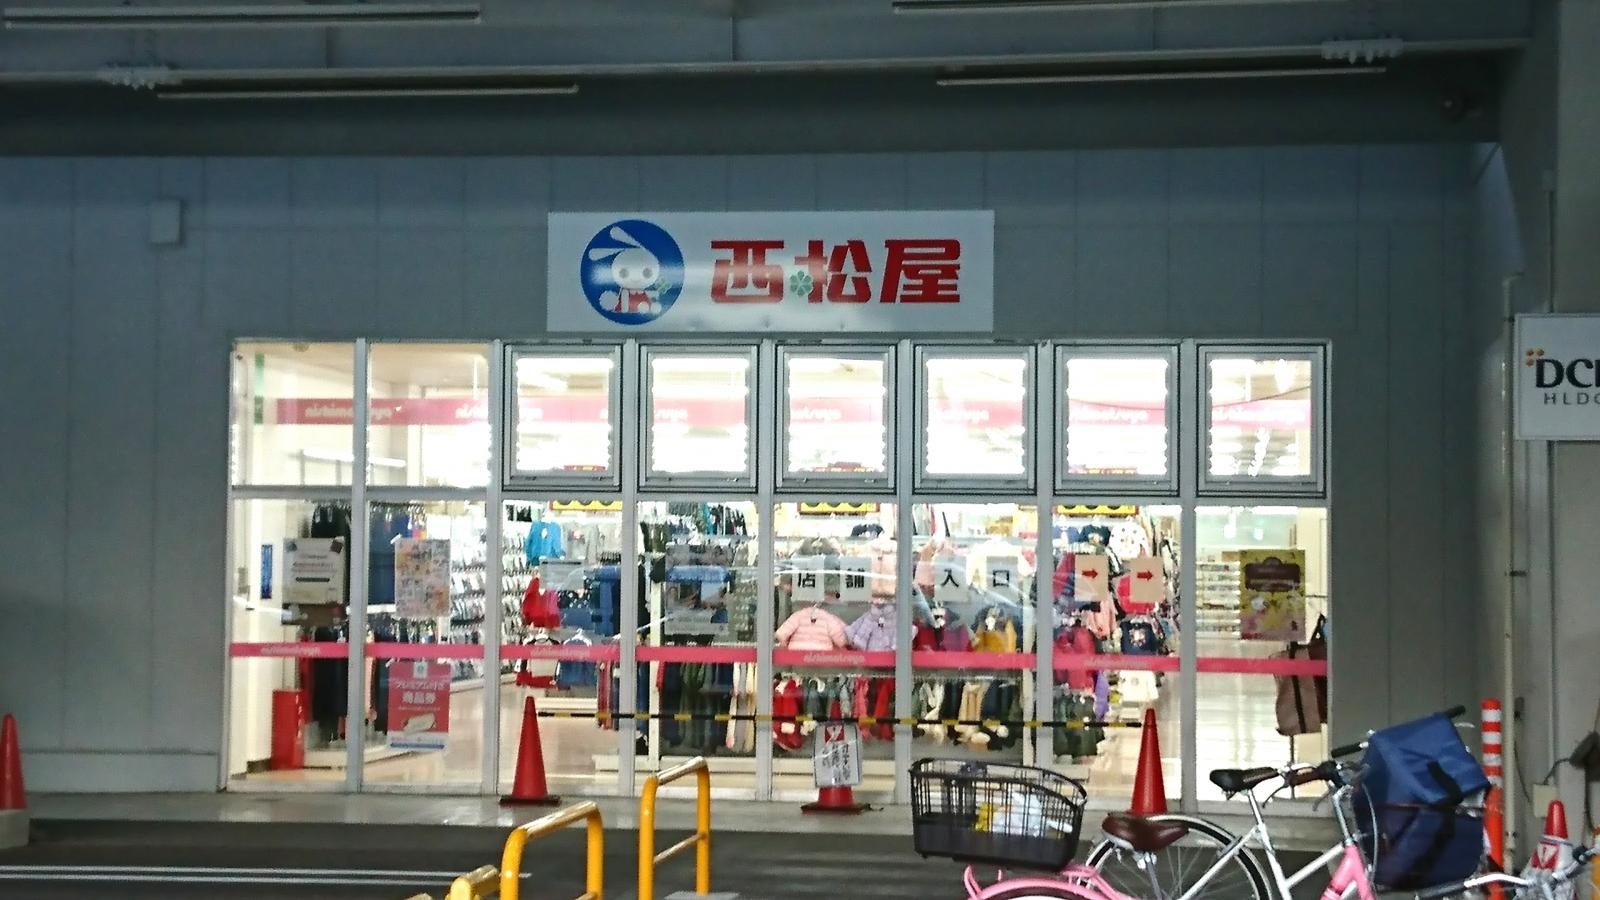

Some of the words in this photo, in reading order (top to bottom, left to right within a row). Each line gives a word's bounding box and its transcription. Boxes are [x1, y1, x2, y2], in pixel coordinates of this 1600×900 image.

[710, 239, 961, 304] 西松屋
[1536, 358, 1600, 388] DC
